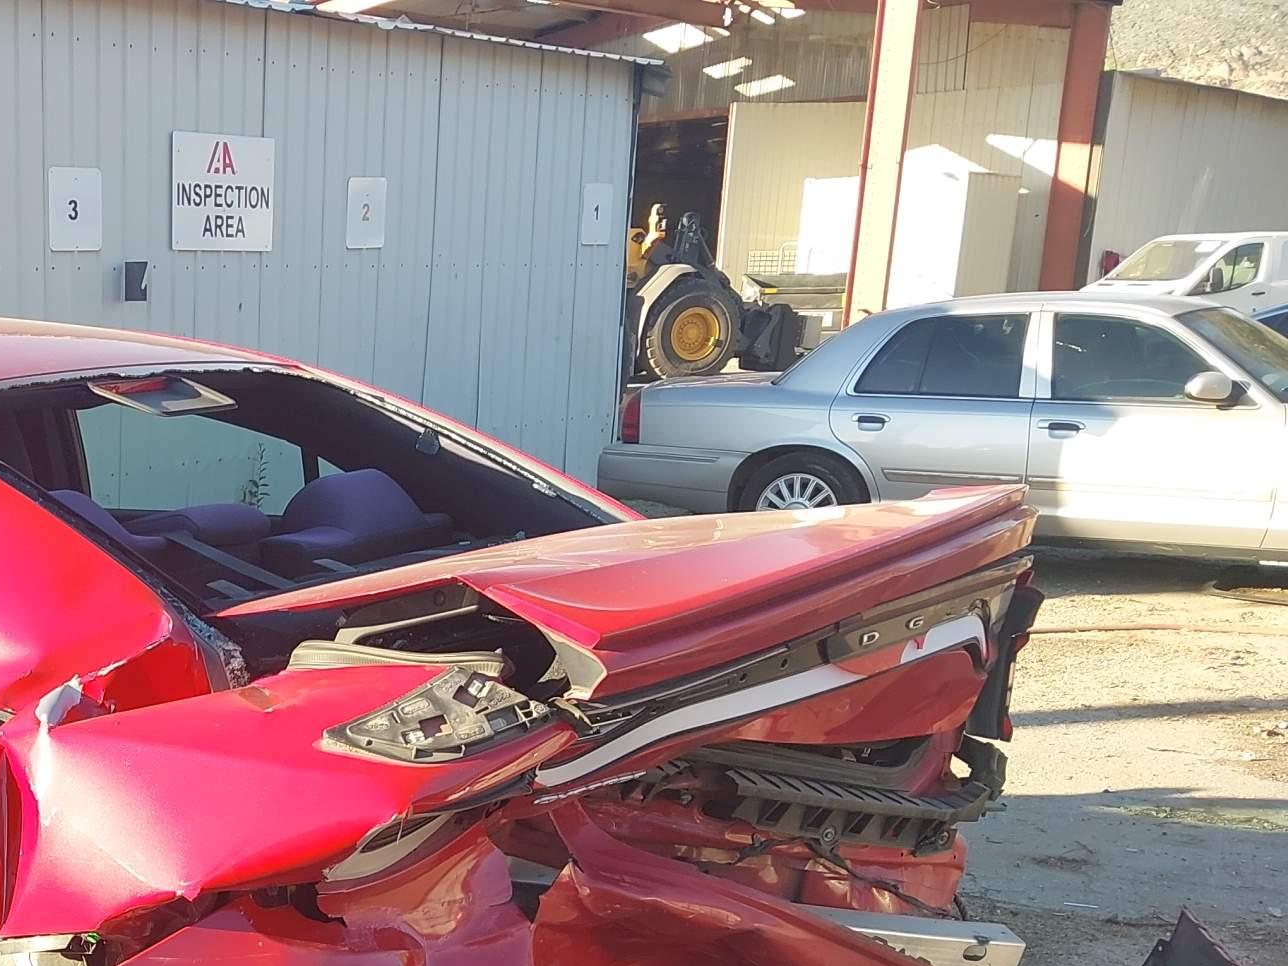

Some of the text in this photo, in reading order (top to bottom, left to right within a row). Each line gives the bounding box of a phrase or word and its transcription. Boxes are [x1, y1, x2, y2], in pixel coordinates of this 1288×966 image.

[177, 182, 270, 209] INSPECTION
[67, 199, 79, 221] 3
[362, 203, 370, 221] 2
[594, 204, 600, 221] 1
[202, 214, 246, 238] AREA
